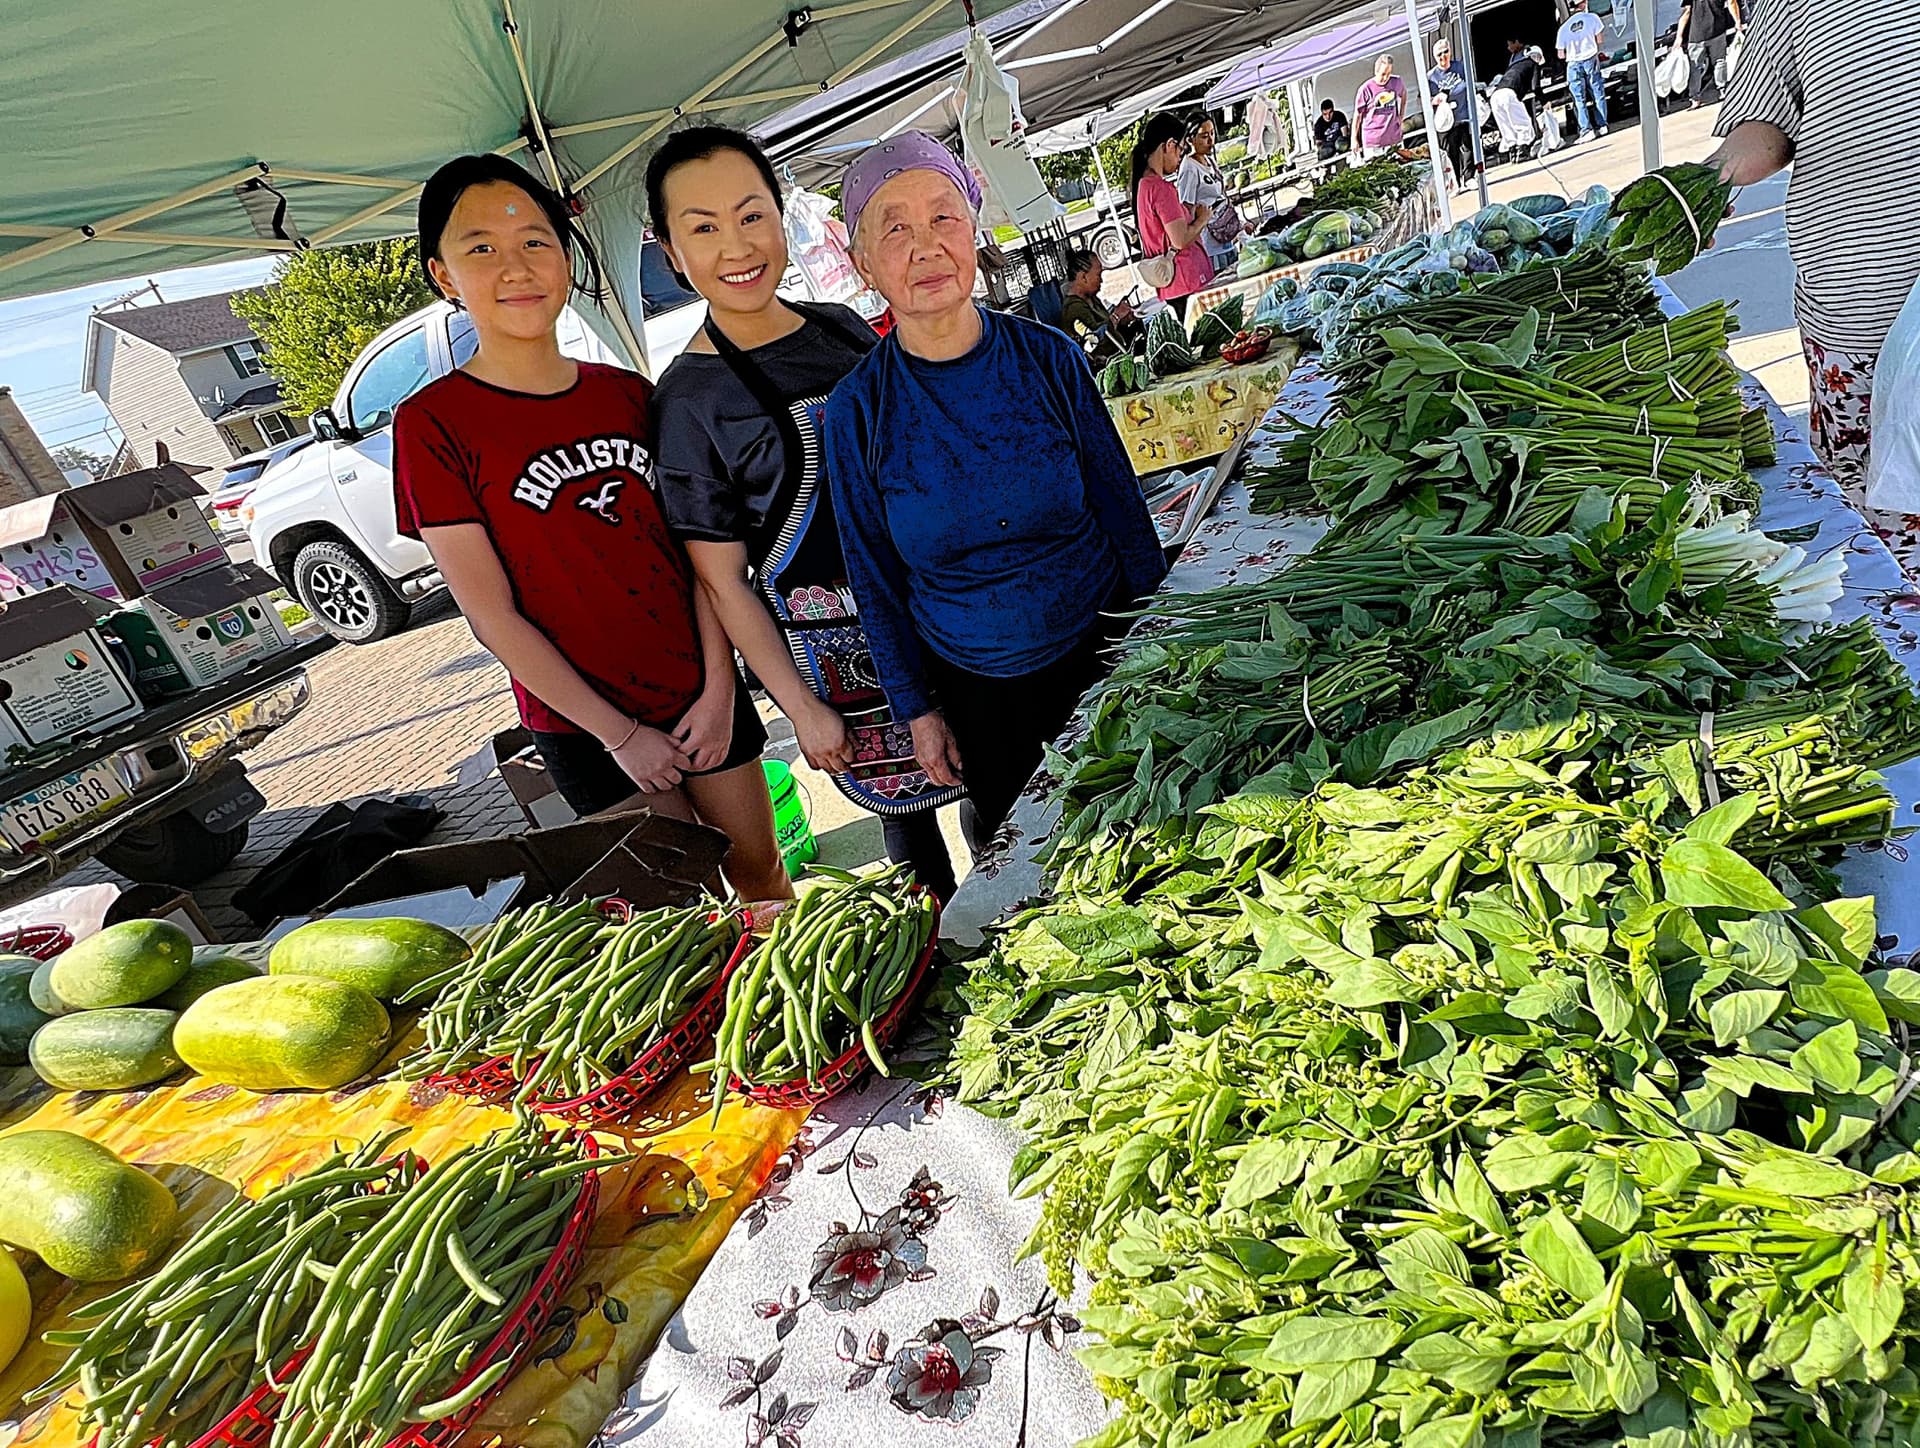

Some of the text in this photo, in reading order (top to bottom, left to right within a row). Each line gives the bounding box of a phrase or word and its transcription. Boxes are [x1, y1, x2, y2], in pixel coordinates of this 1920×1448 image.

[226, 619, 240, 633] 10
[34, 779, 69, 801] IOWA
[15, 800, 66, 838] GZS
[62, 777, 110, 814] 838
[205, 791, 254, 824] 4WD
